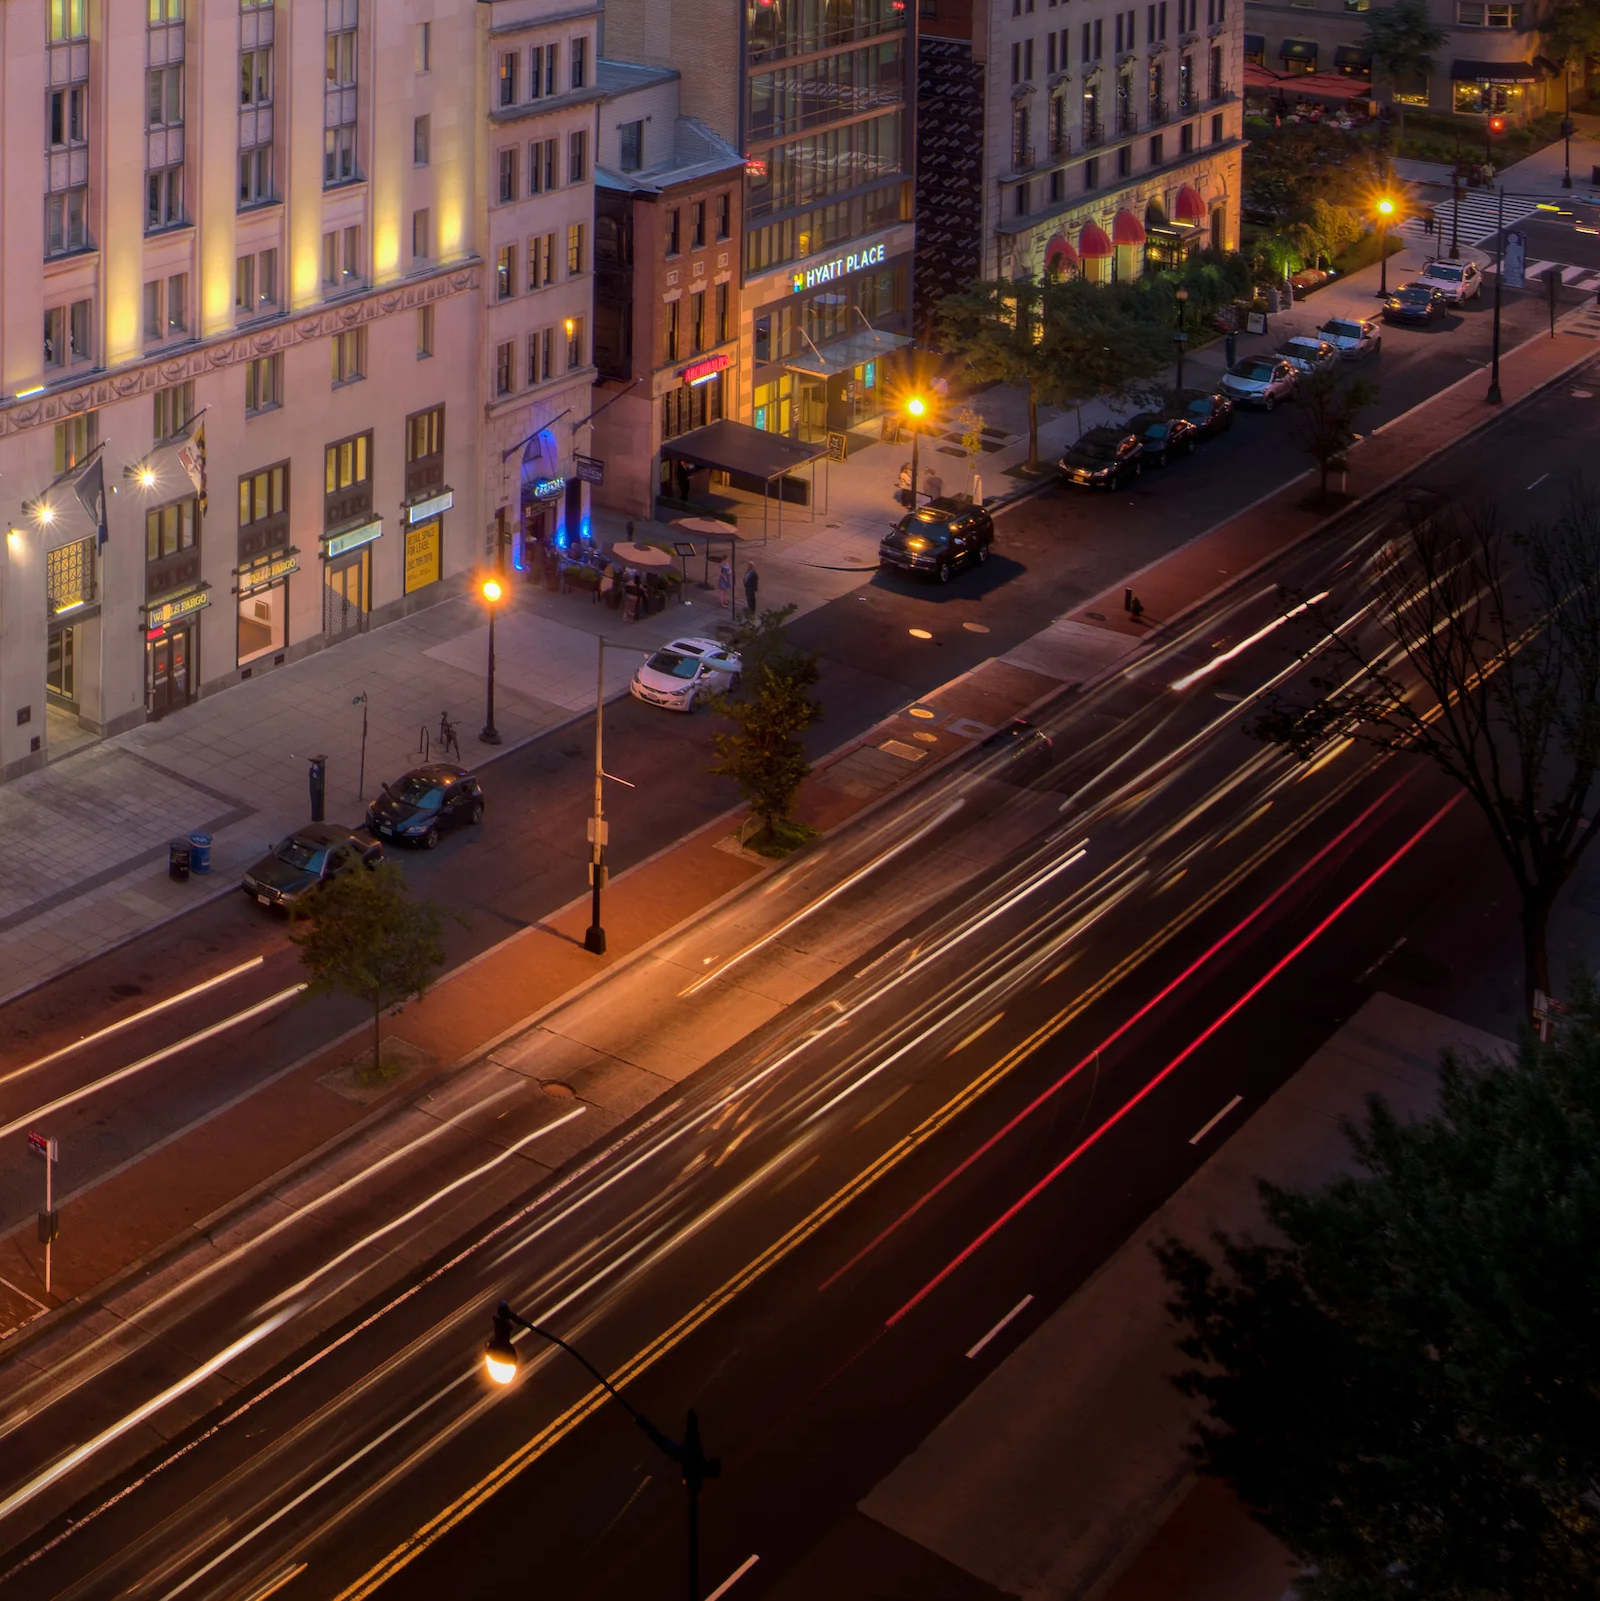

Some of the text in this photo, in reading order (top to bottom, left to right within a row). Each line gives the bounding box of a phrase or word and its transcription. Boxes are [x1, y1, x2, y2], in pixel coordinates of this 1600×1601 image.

[807, 244, 885, 289] HYATT PLACE
[271, 558, 296, 576] FARGO
[153, 593, 207, 623] WLS FARGO
